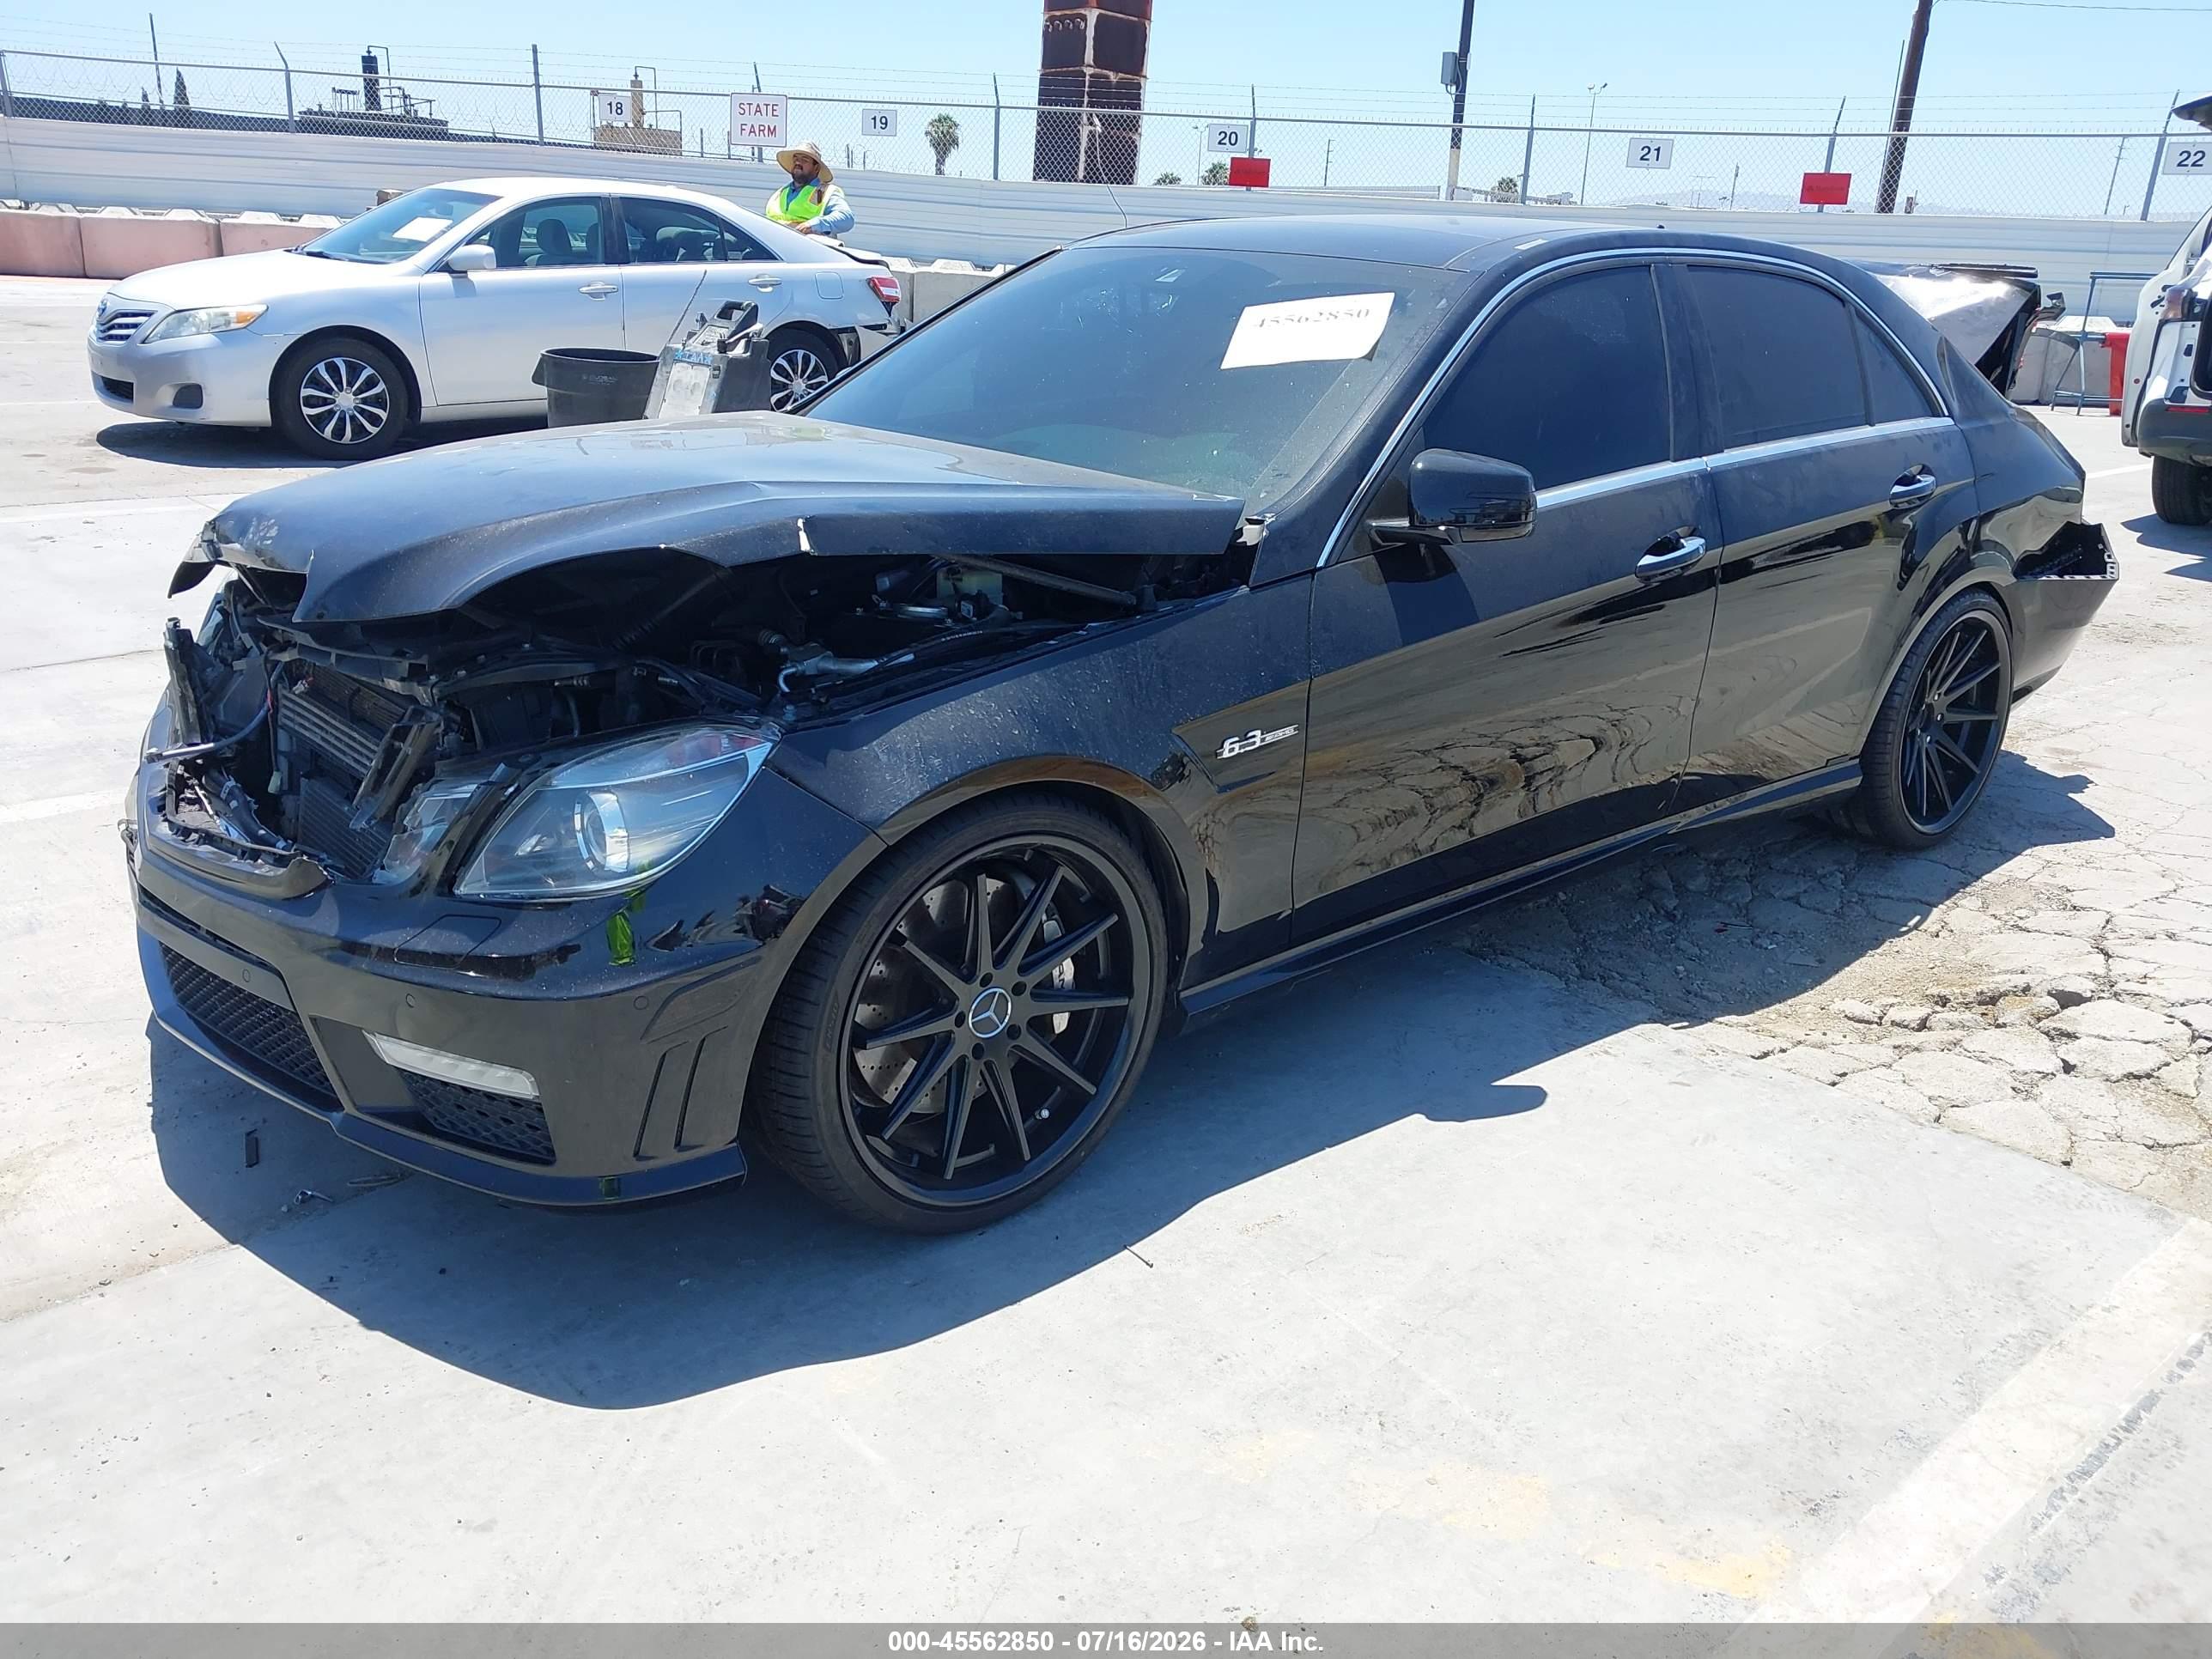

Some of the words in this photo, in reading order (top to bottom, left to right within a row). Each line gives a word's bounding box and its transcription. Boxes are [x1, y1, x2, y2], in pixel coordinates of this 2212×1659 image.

[607, 101, 623, 116] 18
[738, 102, 780, 118] STATE
[739, 124, 777, 138] FARM
[871, 115, 890, 131] 19
[1217, 131, 1238, 146] 20
[1639, 145, 1662, 161] 21
[2176, 150, 2206, 167] 22
